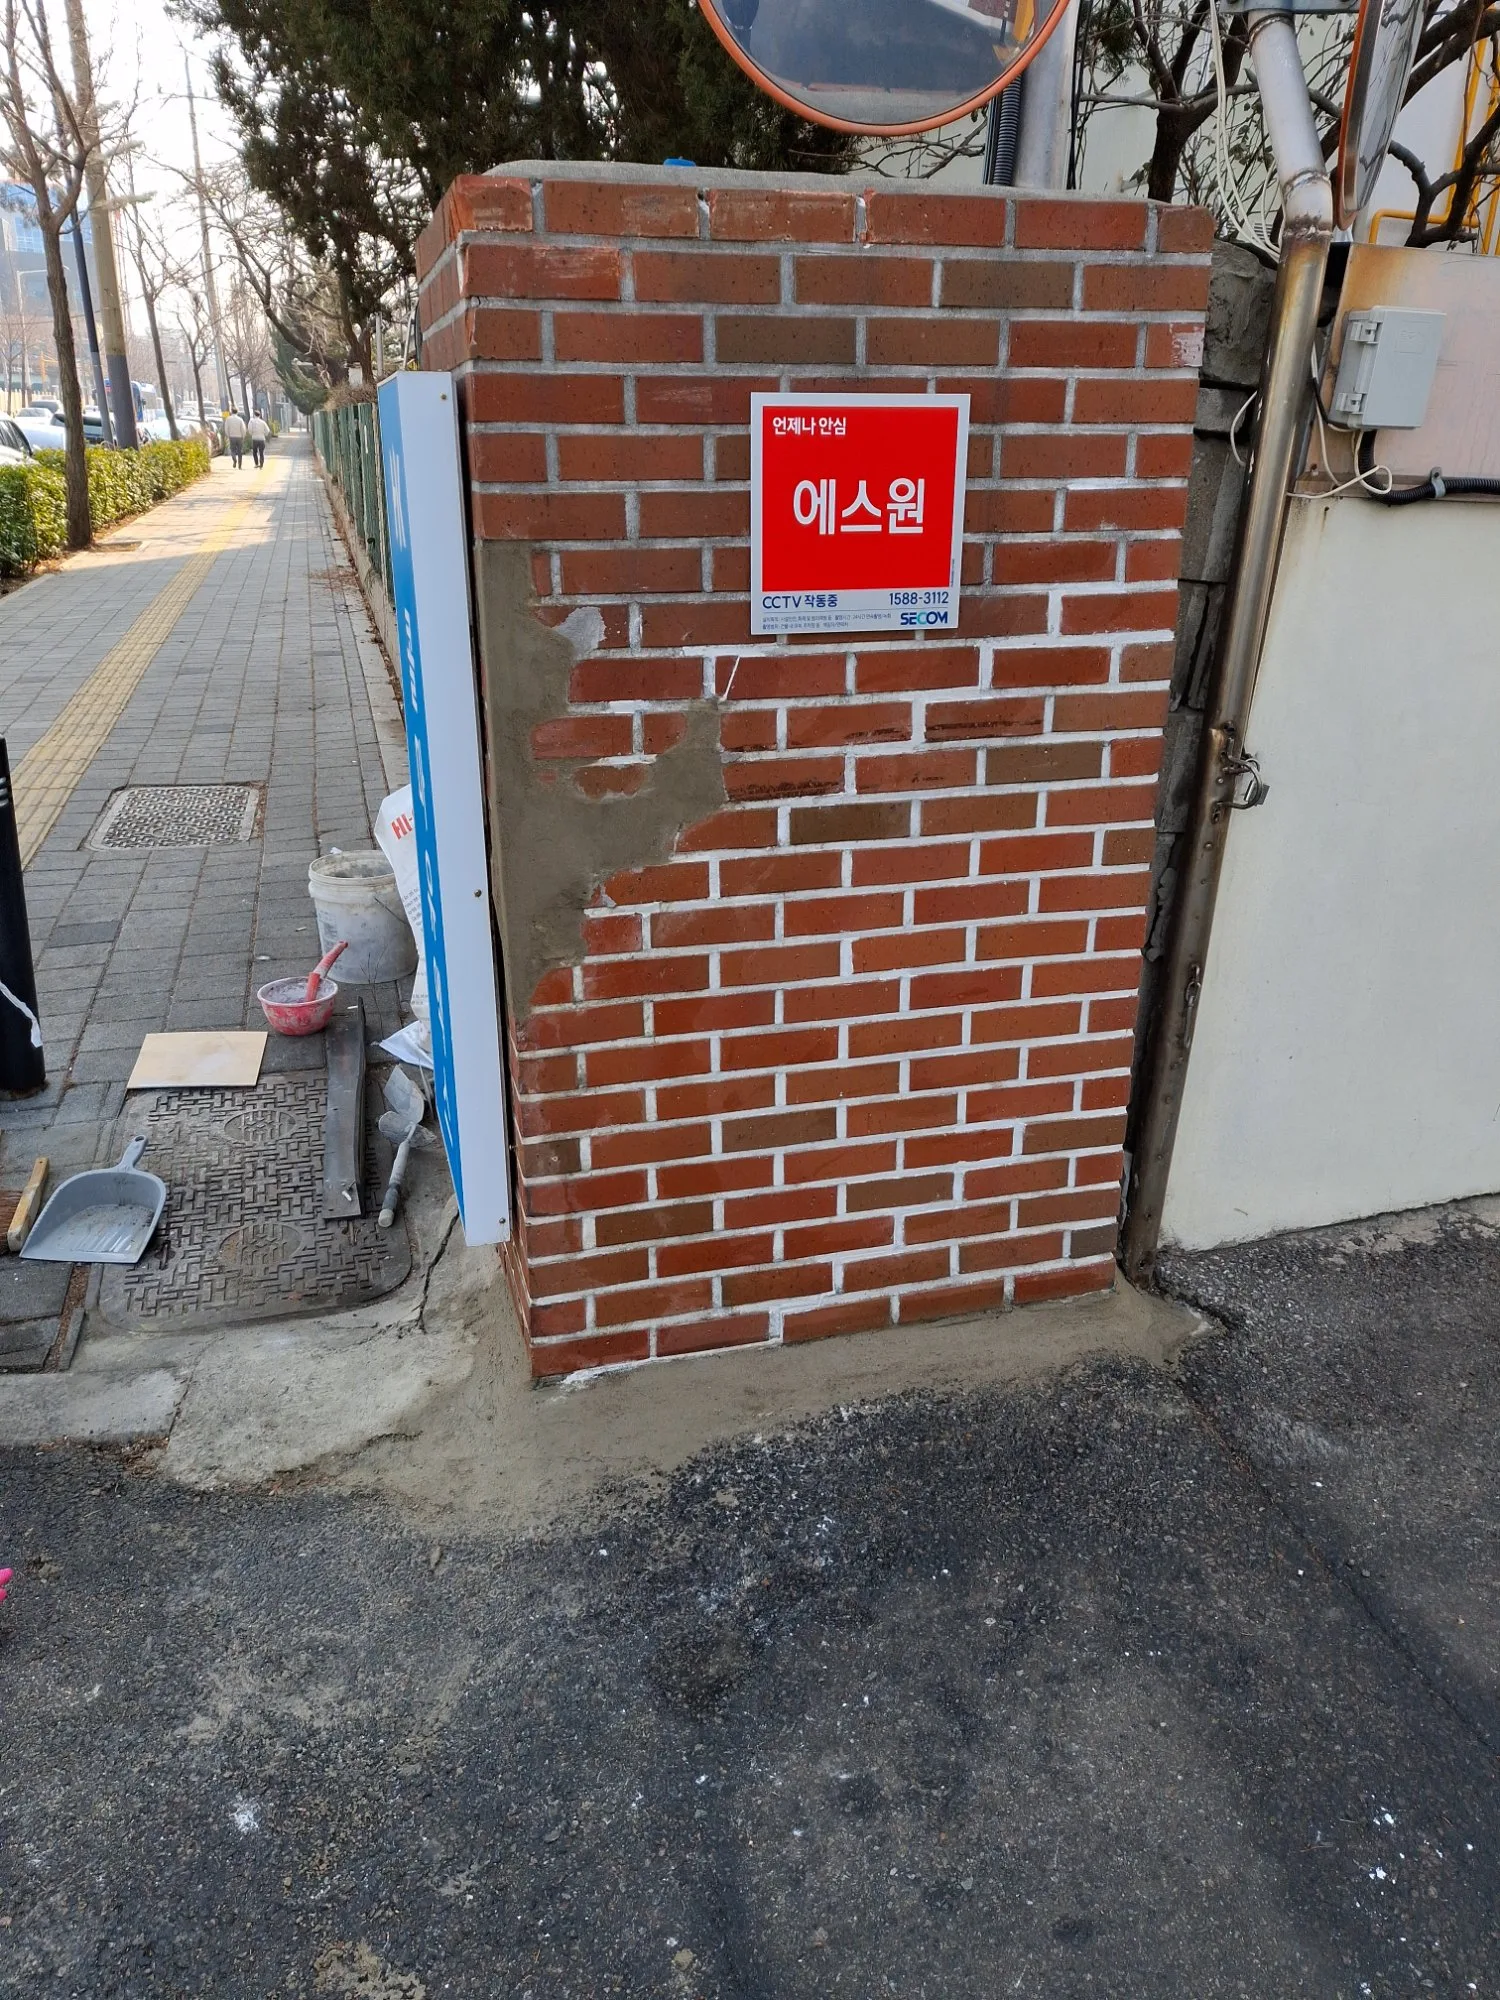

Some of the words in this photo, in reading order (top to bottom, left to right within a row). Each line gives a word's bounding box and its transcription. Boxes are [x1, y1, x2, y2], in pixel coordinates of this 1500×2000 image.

[773, 417, 816, 436] 언제나
[819, 417, 847, 436] 안심
[793, 478, 925, 535] 에스원
[762, 595, 801, 610] CCTV
[804, 594, 838, 608] 작동중
[889, 591, 949, 605] 1588-3112
[900, 610, 948, 626] SECOM
